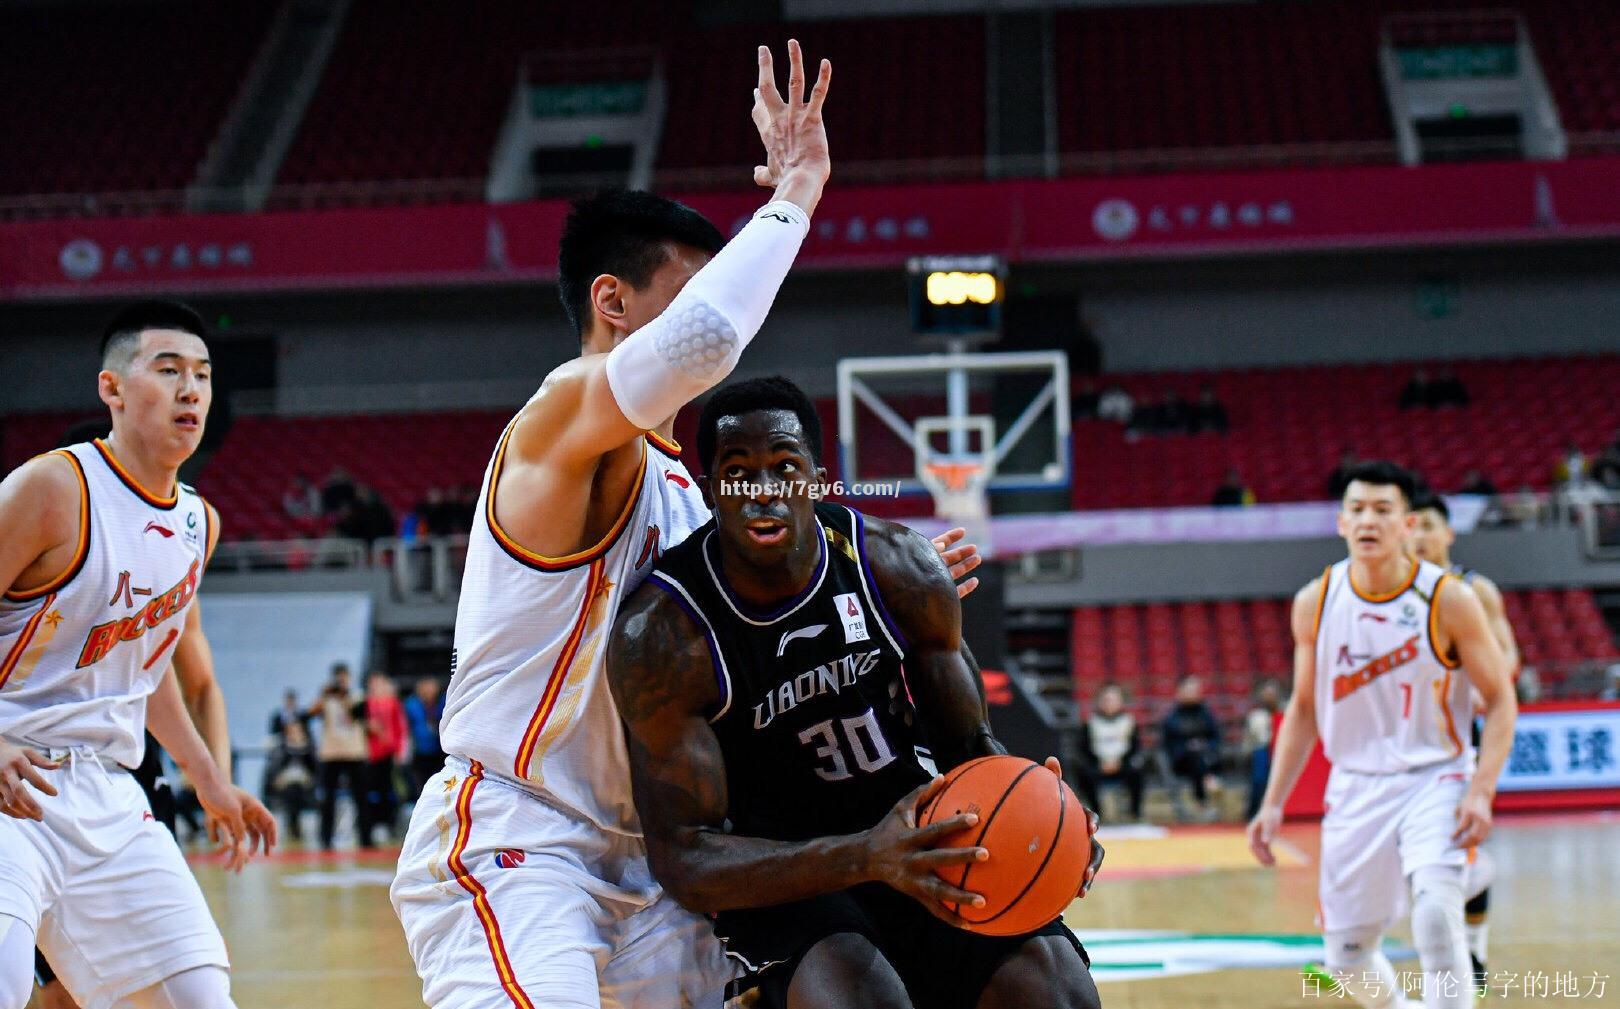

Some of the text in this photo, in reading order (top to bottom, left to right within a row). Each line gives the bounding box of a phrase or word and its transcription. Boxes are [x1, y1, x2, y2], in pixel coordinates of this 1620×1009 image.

[109, 570, 152, 608] 八一
[143, 627, 178, 670] 1
[1400, 683, 1412, 719] 1
[798, 707, 897, 781] 30
